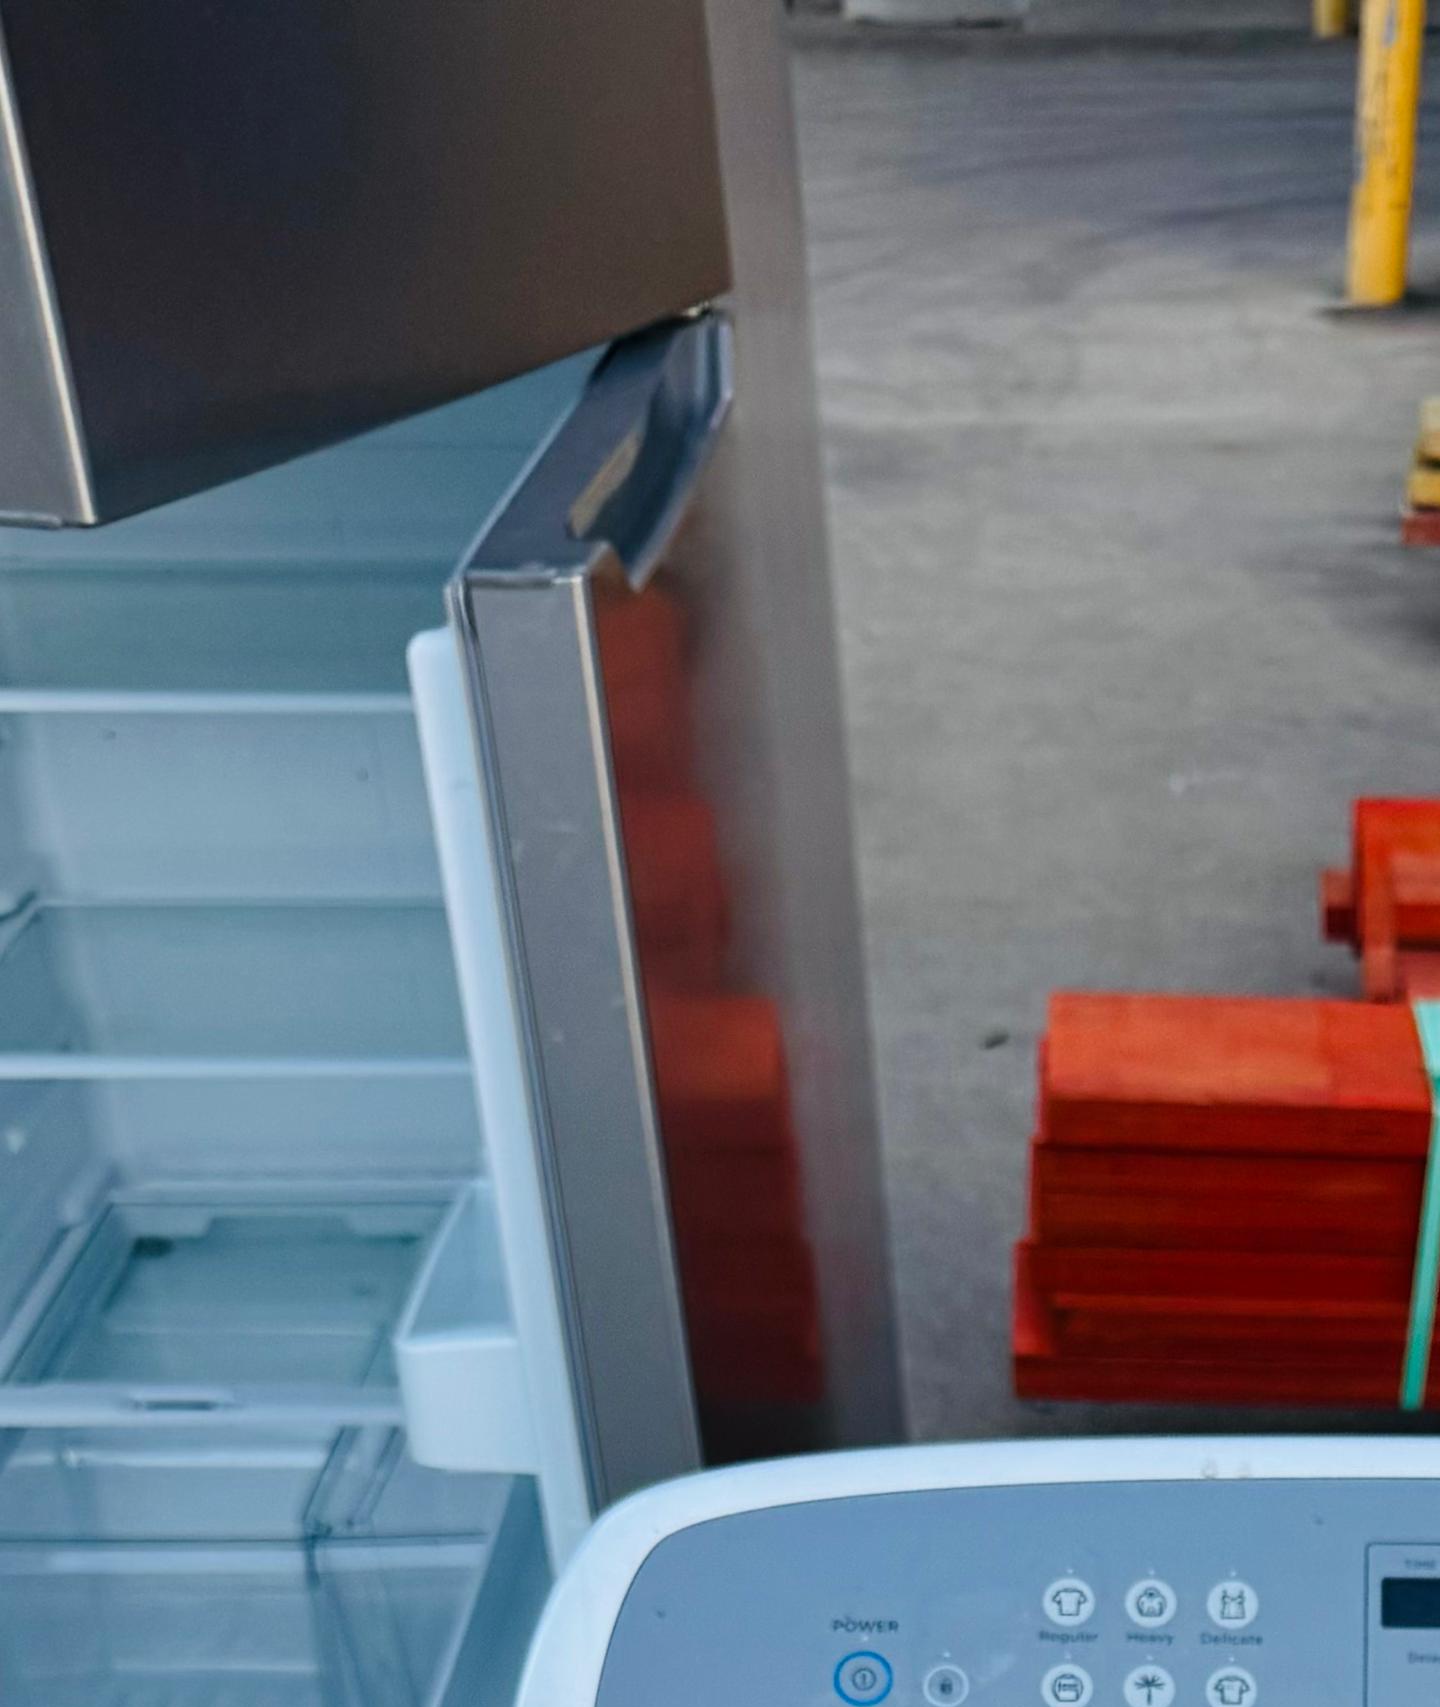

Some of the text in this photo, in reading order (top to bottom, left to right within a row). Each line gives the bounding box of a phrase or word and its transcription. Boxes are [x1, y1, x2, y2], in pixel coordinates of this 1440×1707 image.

[832, 1619, 899, 1633] POWER
[1039, 1630, 1098, 1644] Regular
[1126, 1632, 1175, 1646] Heavy
[1201, 1633, 1263, 1646] Delicate
